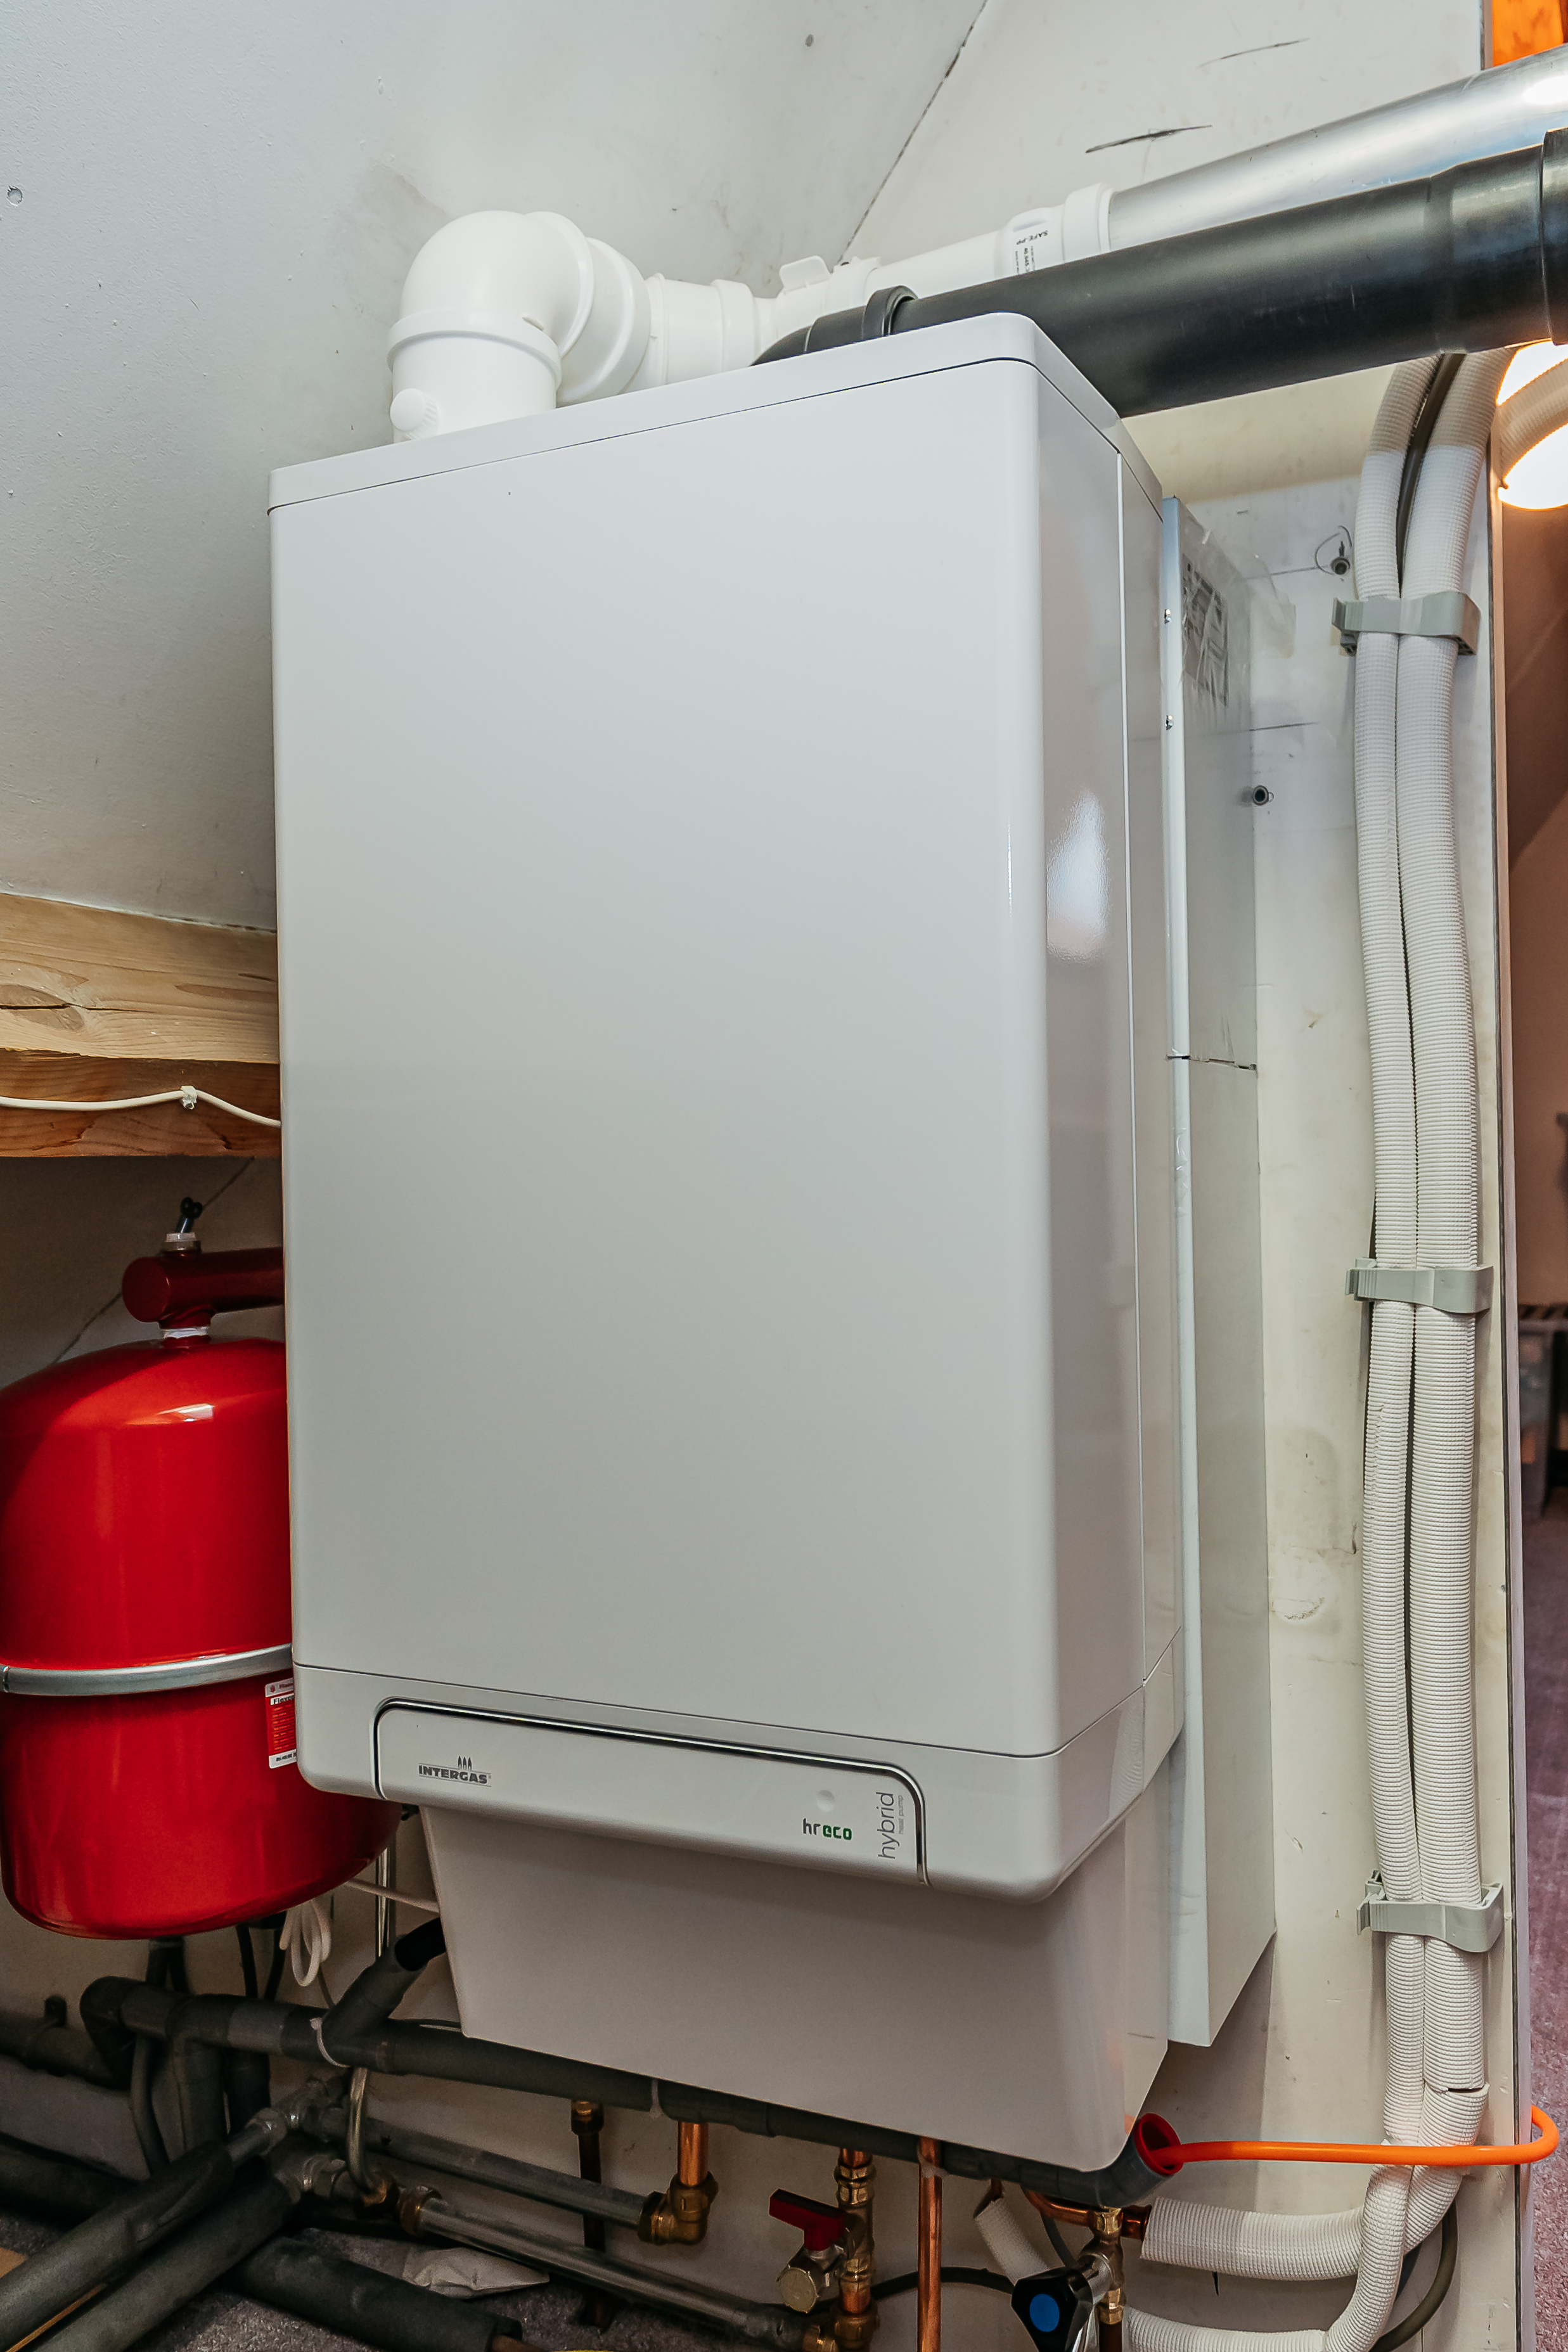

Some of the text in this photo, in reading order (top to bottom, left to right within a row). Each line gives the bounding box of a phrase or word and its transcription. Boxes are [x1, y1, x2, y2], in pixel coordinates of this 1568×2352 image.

[418, 1765, 487, 1784] INTERGAS
[802, 1818, 852, 1841] hreco
[875, 1792, 900, 1860] hybrid
